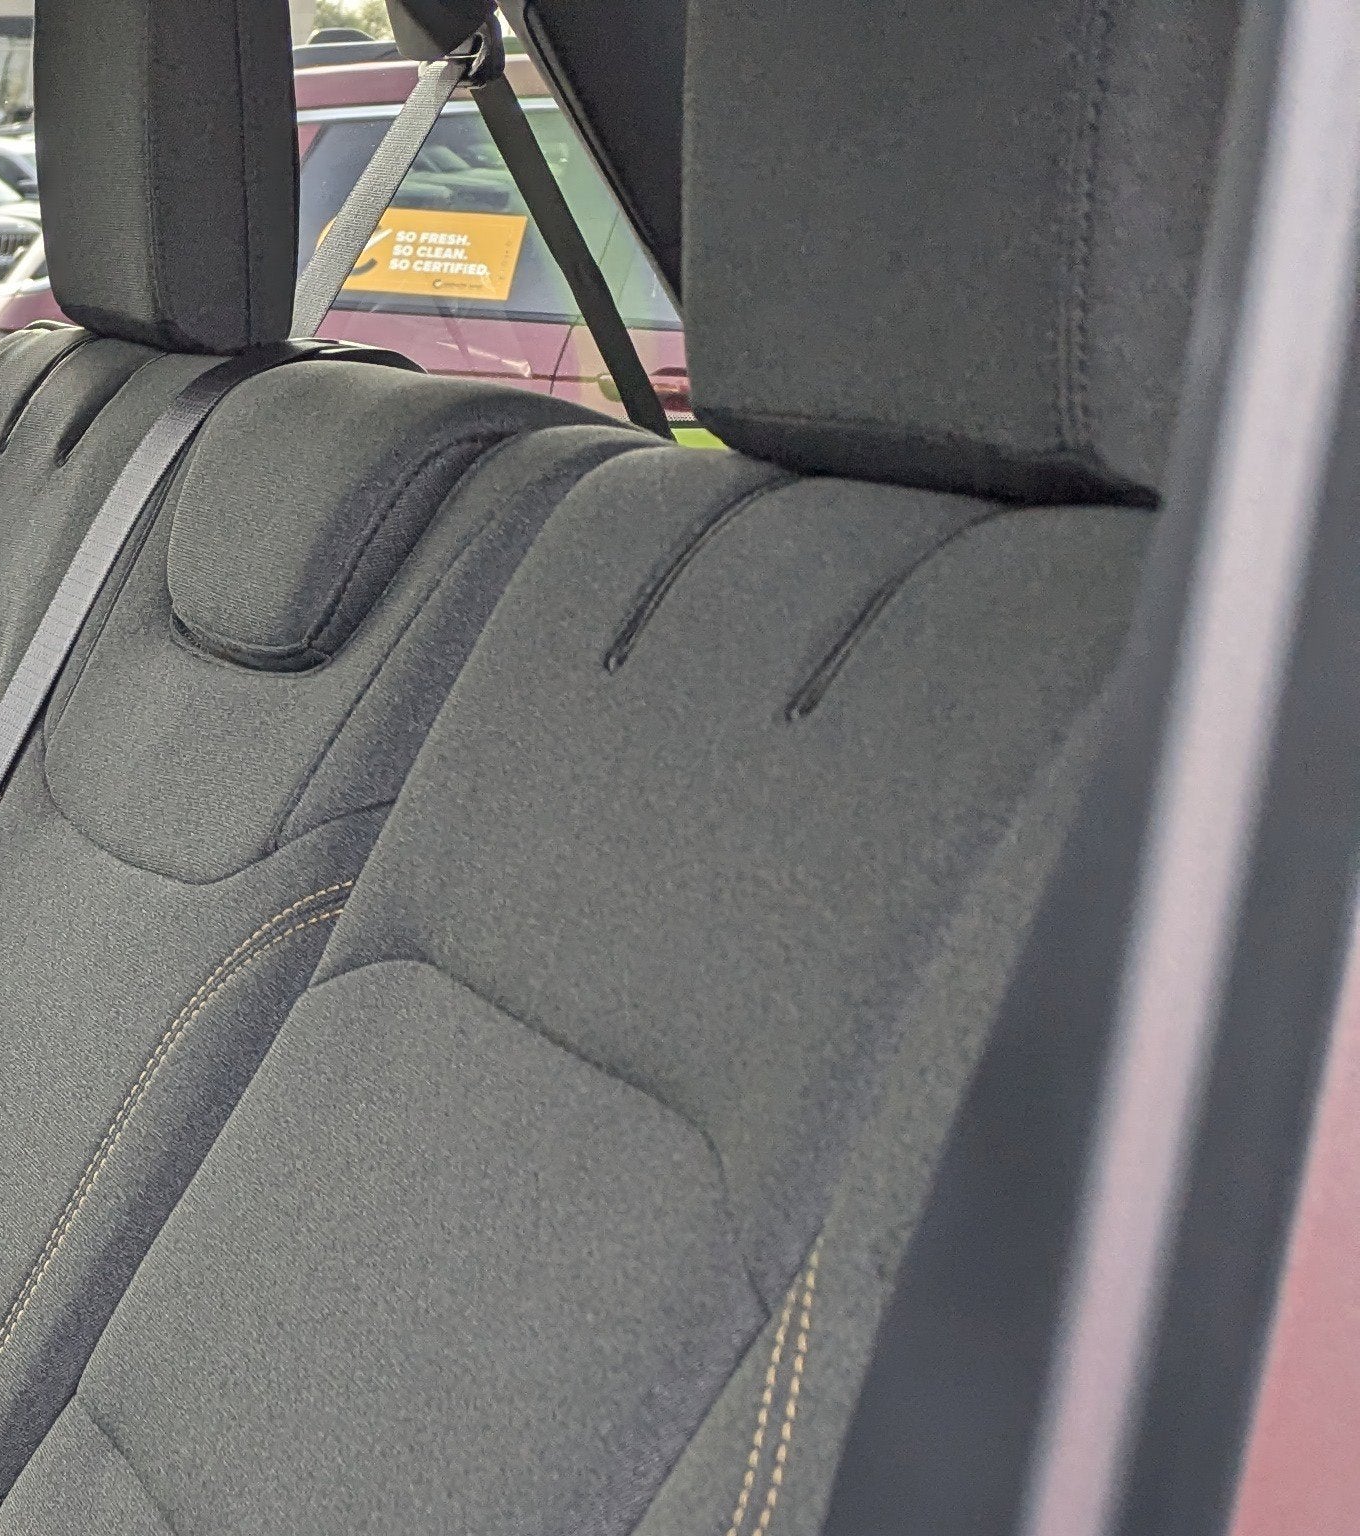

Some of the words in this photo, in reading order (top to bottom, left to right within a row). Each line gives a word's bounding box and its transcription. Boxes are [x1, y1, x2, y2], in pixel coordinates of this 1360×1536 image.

[395, 230, 417, 243] SO
[419, 231, 471, 246] FRESH.
[392, 244, 414, 257] SO
[416, 245, 469, 260] CLEAN.
[388, 258, 410, 271] SO
[412, 259, 490, 276] CERTIFIED.
